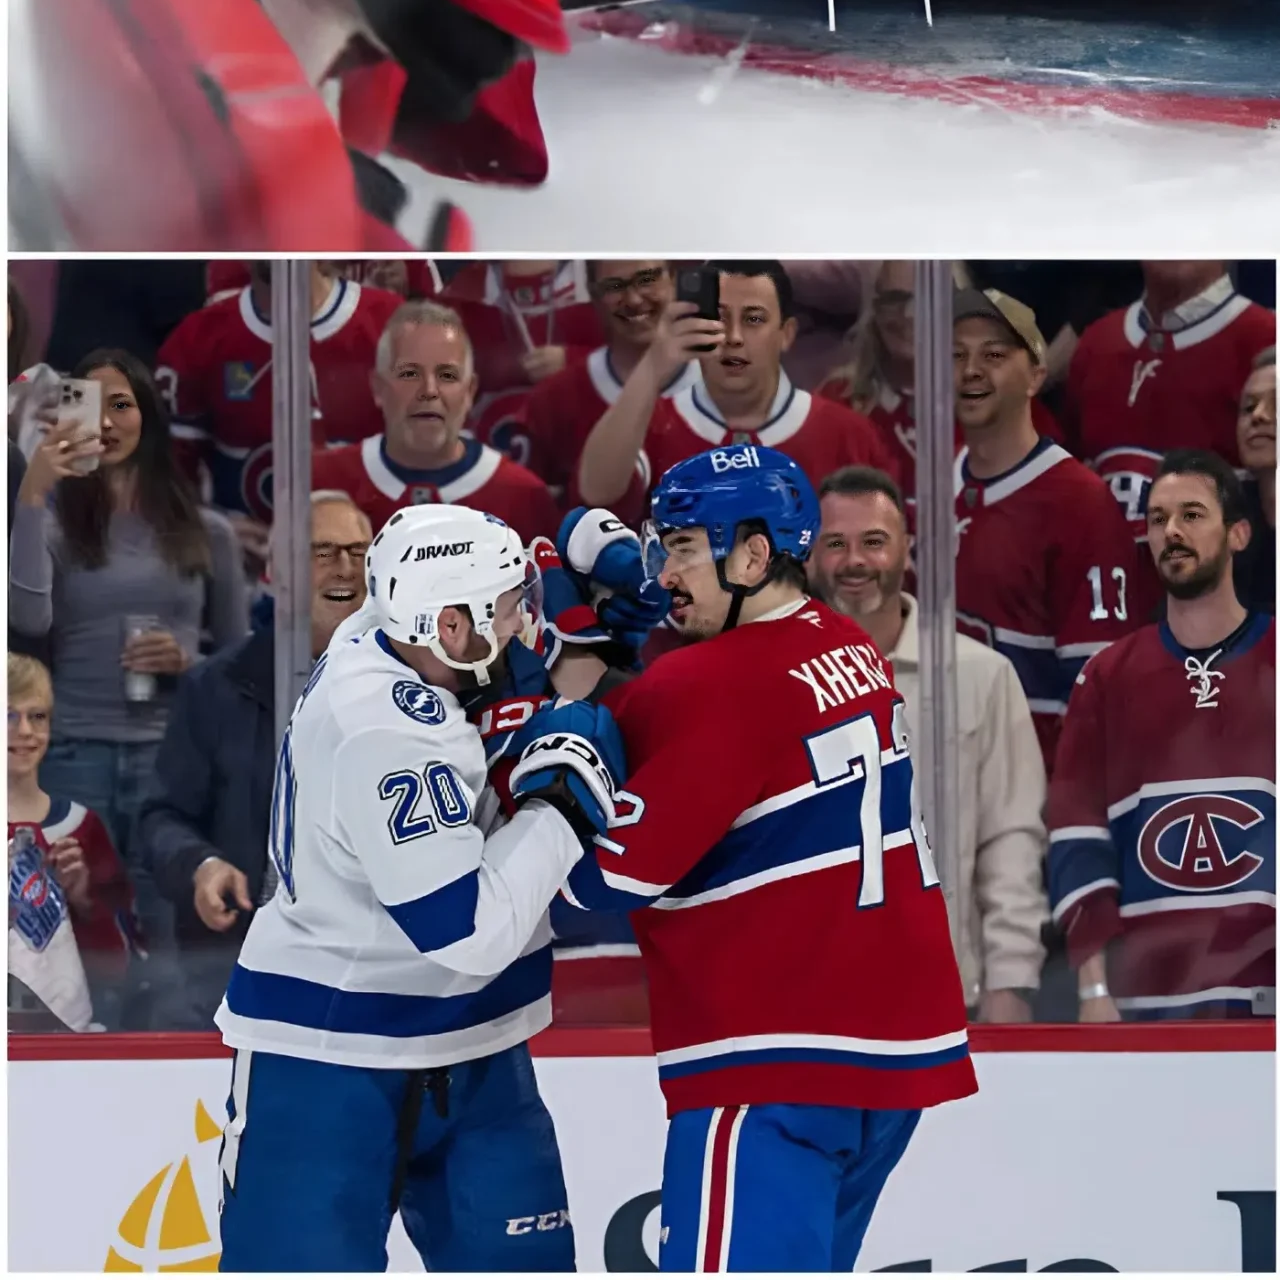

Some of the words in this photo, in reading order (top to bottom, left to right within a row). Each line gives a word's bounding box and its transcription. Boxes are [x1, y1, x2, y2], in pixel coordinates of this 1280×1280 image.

[709, 445, 760, 473] Bell
[1086, 565, 1128, 621] 13
[377, 760, 472, 846] 20
